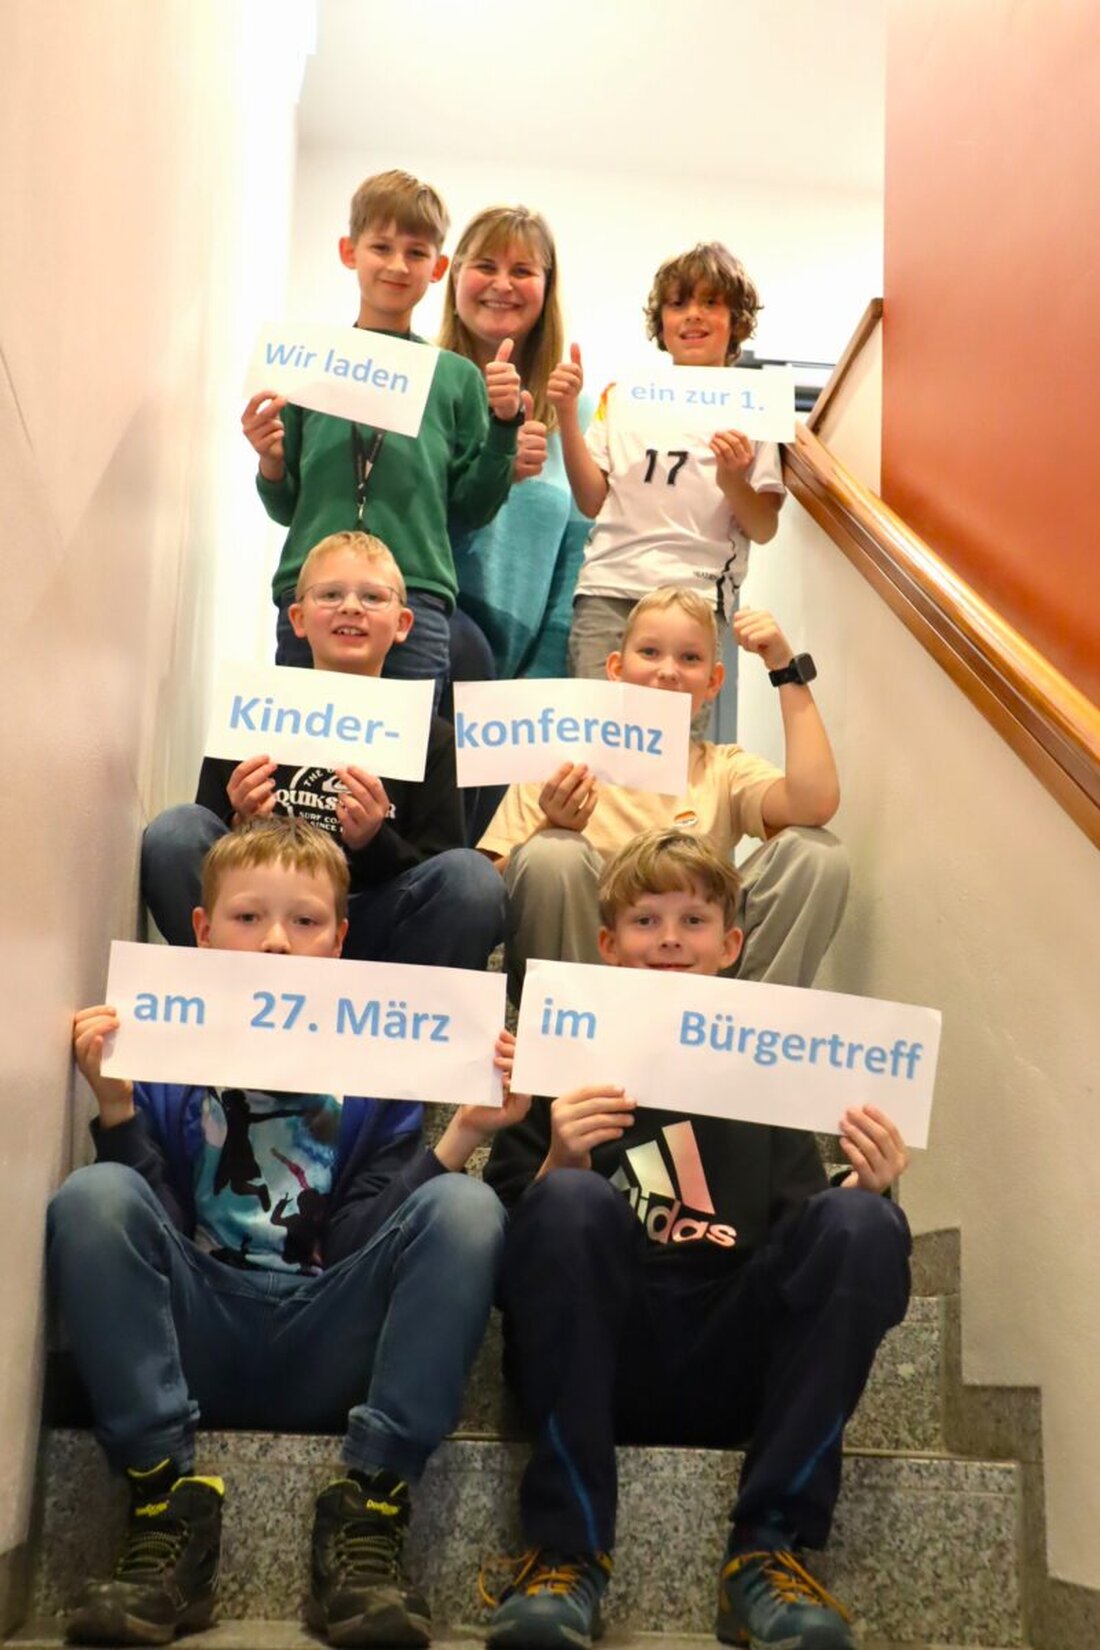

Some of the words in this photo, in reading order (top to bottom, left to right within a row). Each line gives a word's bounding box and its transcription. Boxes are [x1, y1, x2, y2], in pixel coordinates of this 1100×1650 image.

[265, 340, 316, 369] Wir
[323, 350, 411, 393] laden
[631, 383, 676, 401] ein
[686, 388, 730, 407] zur
[740, 388, 765, 412] 1.
[643, 448, 689, 486] 17
[229, 695, 399, 745] Kinder-
[454, 707, 663, 756] konferenz
[303, 769, 324, 786] THE
[275, 788, 397, 819] QUIKSR
[134, 992, 205, 1025] am
[250, 991, 319, 1033] 27.
[336, 997, 451, 1043] März
[541, 997, 597, 1040] im
[679, 1010, 923, 1080] Bürgertreff
